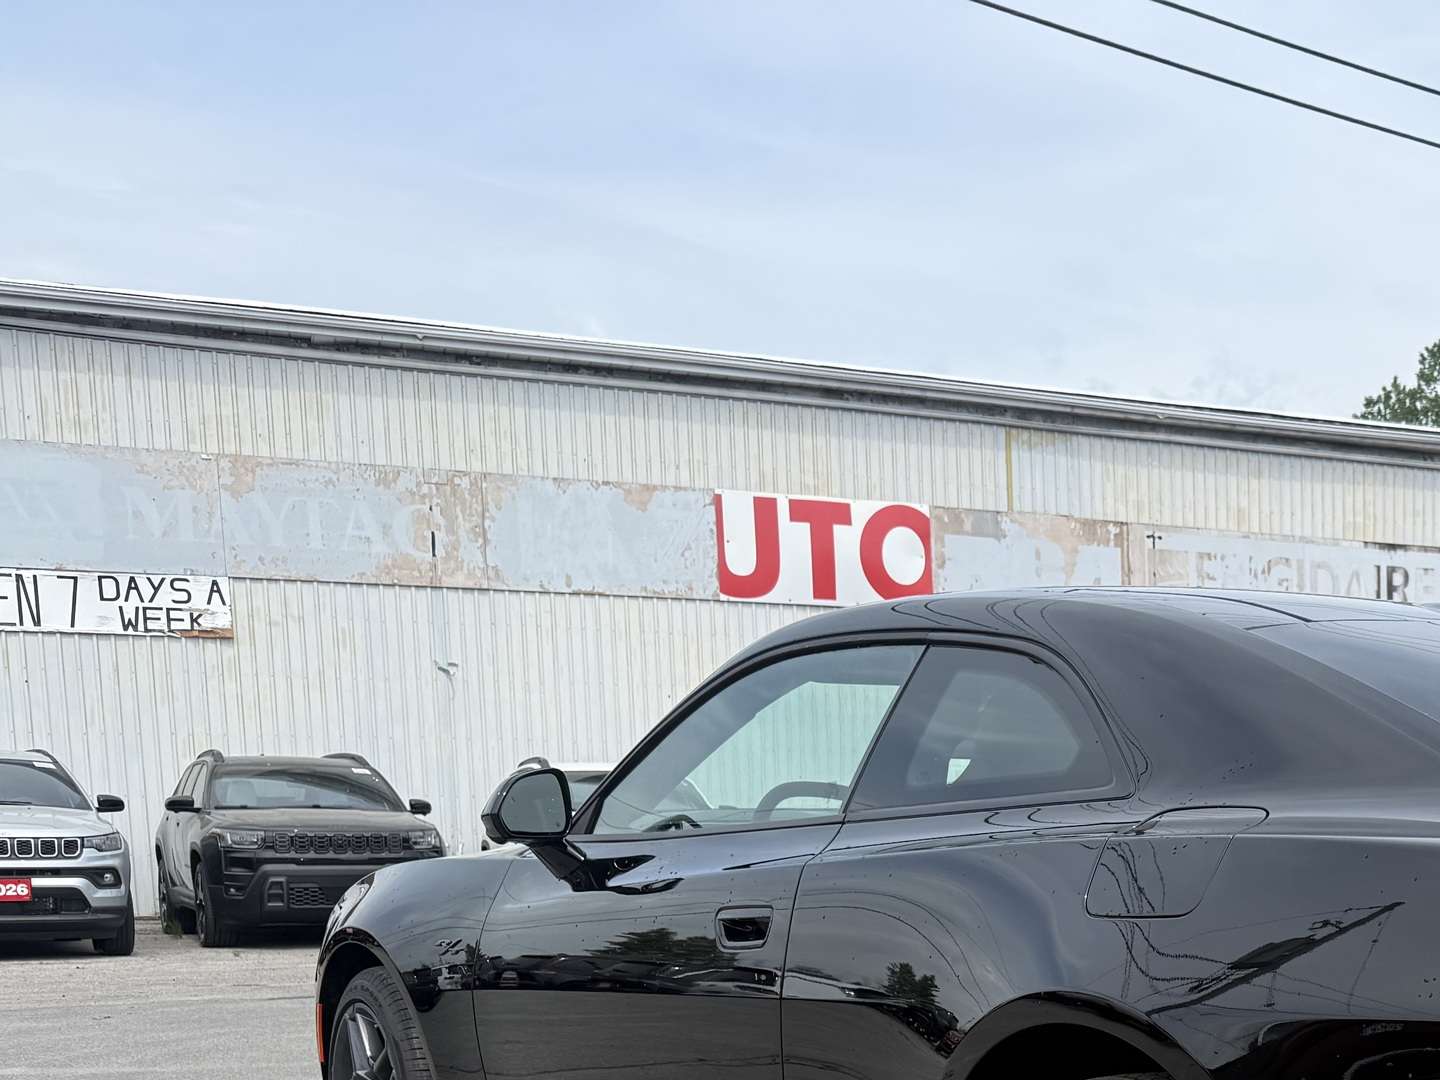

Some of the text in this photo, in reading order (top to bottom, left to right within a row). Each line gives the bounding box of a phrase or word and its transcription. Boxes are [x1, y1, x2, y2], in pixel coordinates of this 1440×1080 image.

[714, 493, 934, 601] UTO
[56, 575, 78, 628] 7
[98, 575, 192, 604] DAYS
[207, 579, 226, 606] A
[118, 605, 203, 633] WEEK
